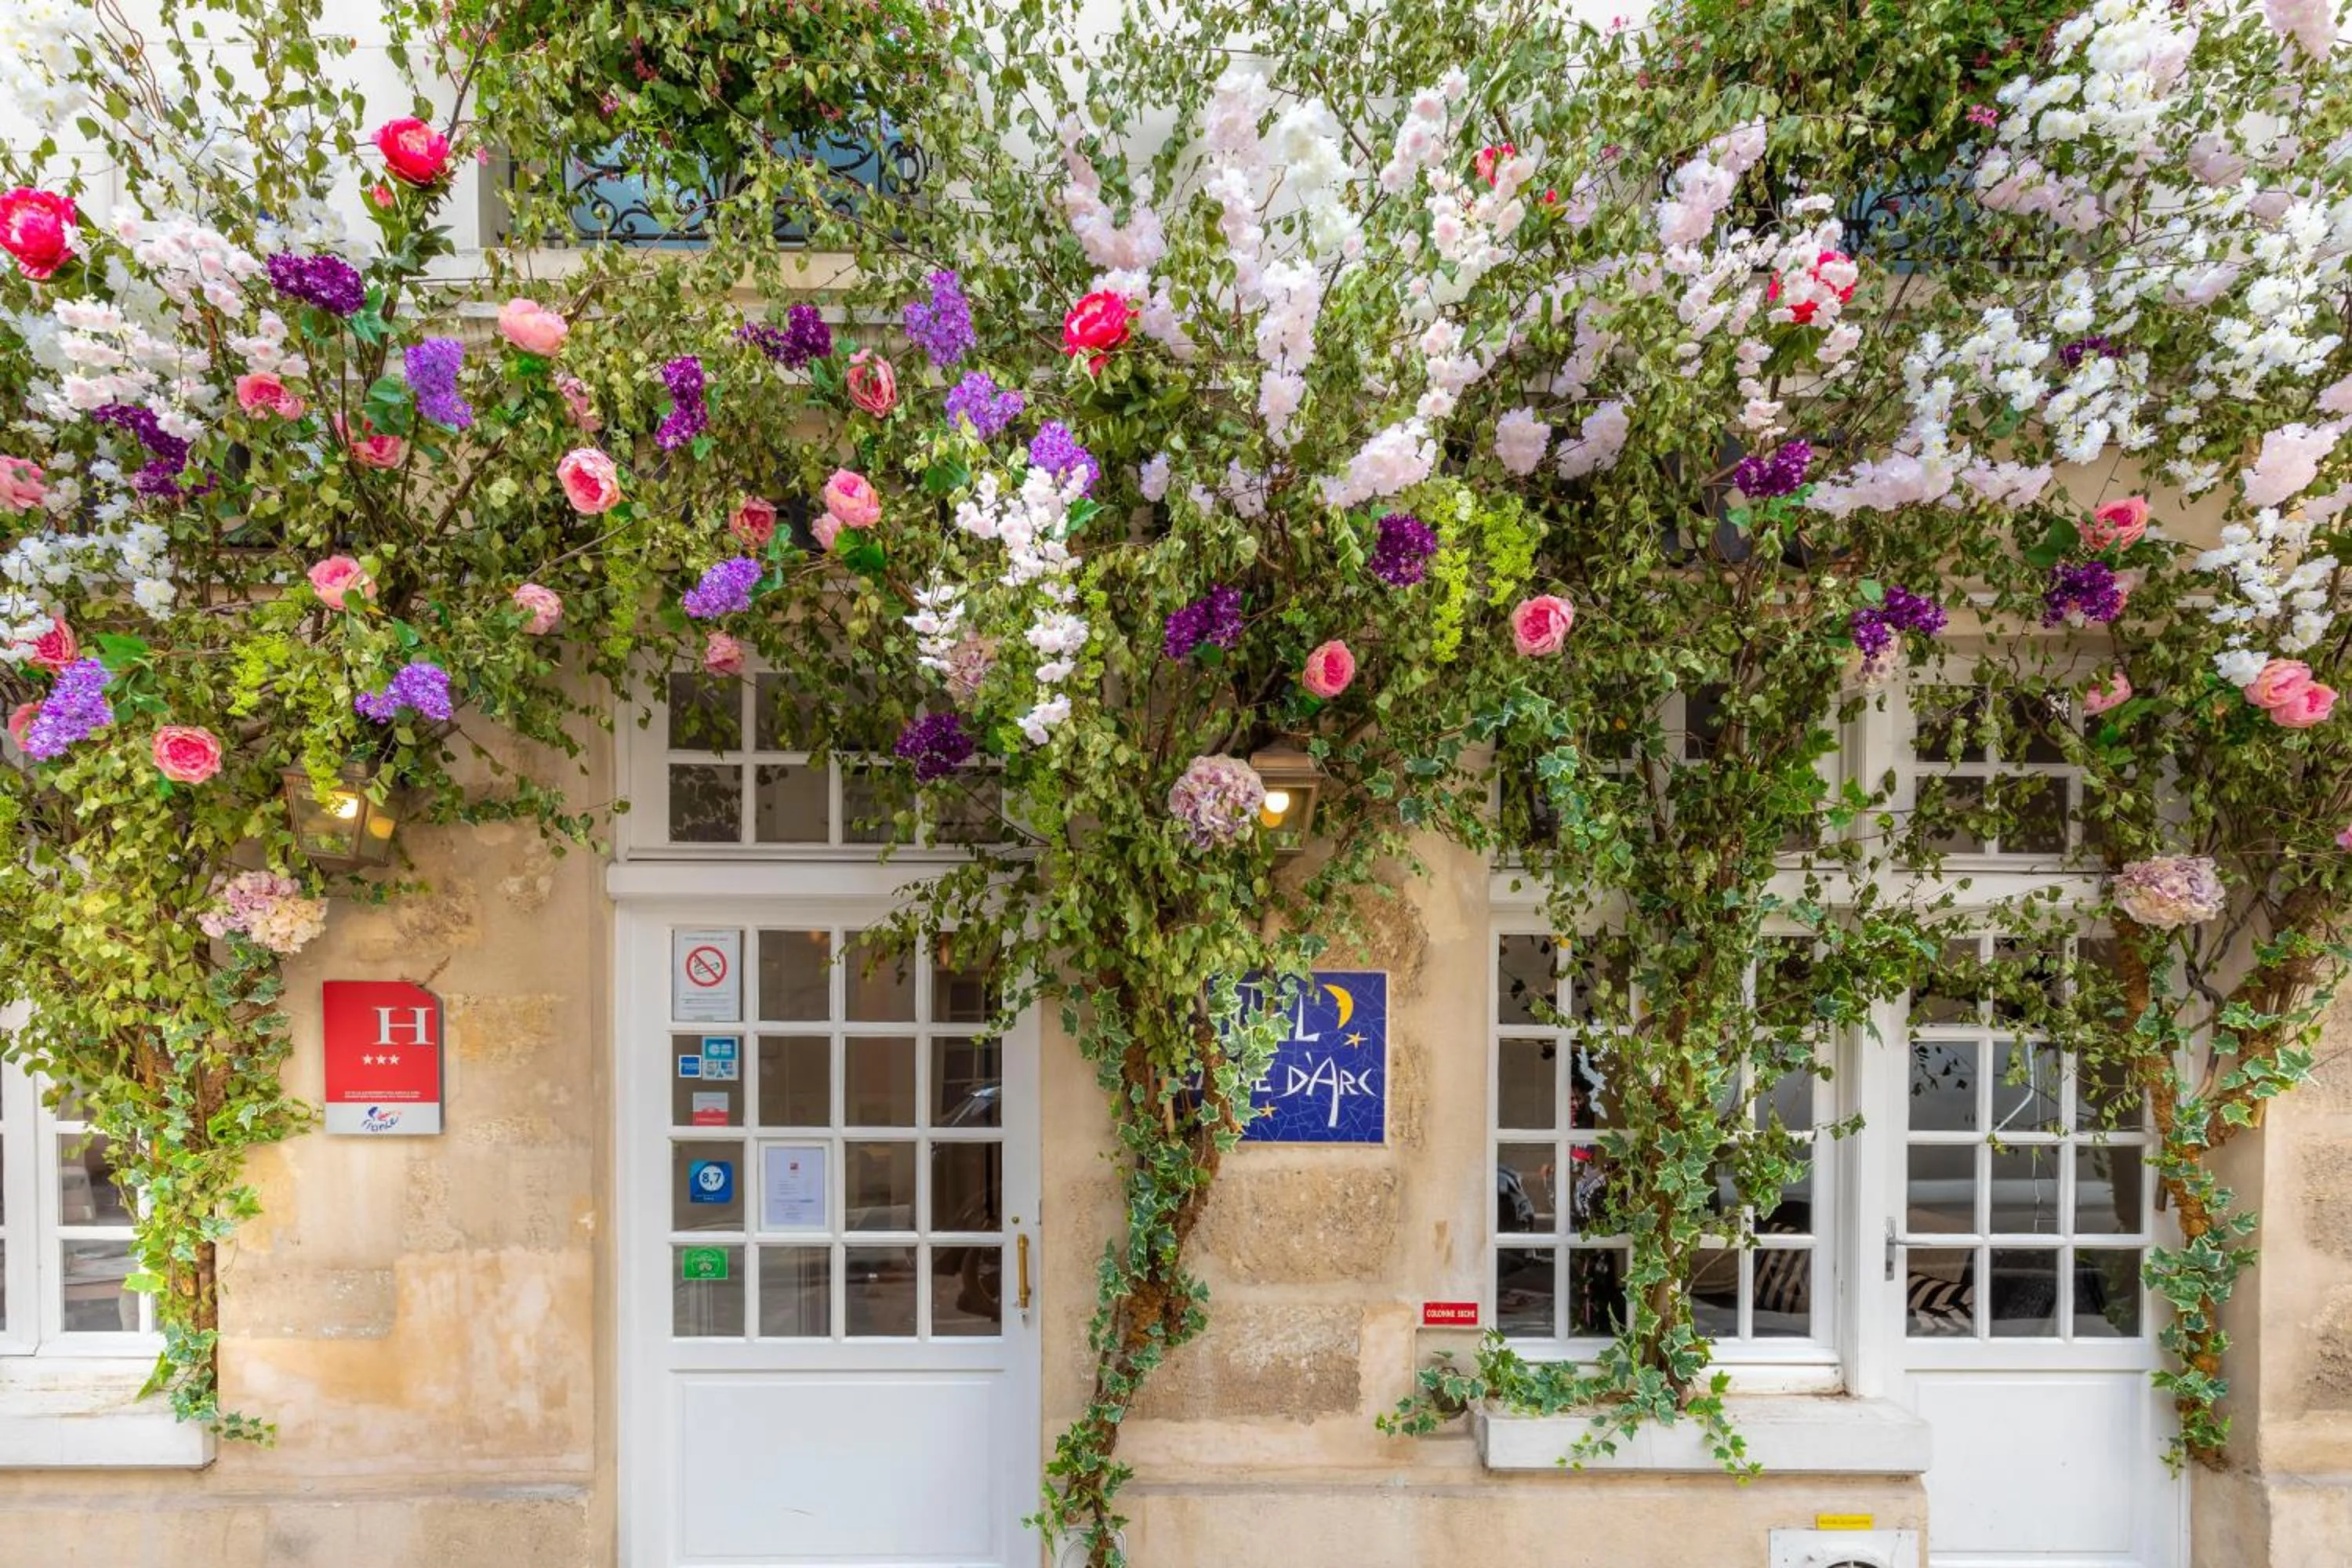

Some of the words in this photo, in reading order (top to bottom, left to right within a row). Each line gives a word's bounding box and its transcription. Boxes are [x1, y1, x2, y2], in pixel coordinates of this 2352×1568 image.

[372, 1007, 435, 1045] H
[702, 1172, 721, 1185] 8,7
[1426, 1309, 1455, 1318] COLONNE
